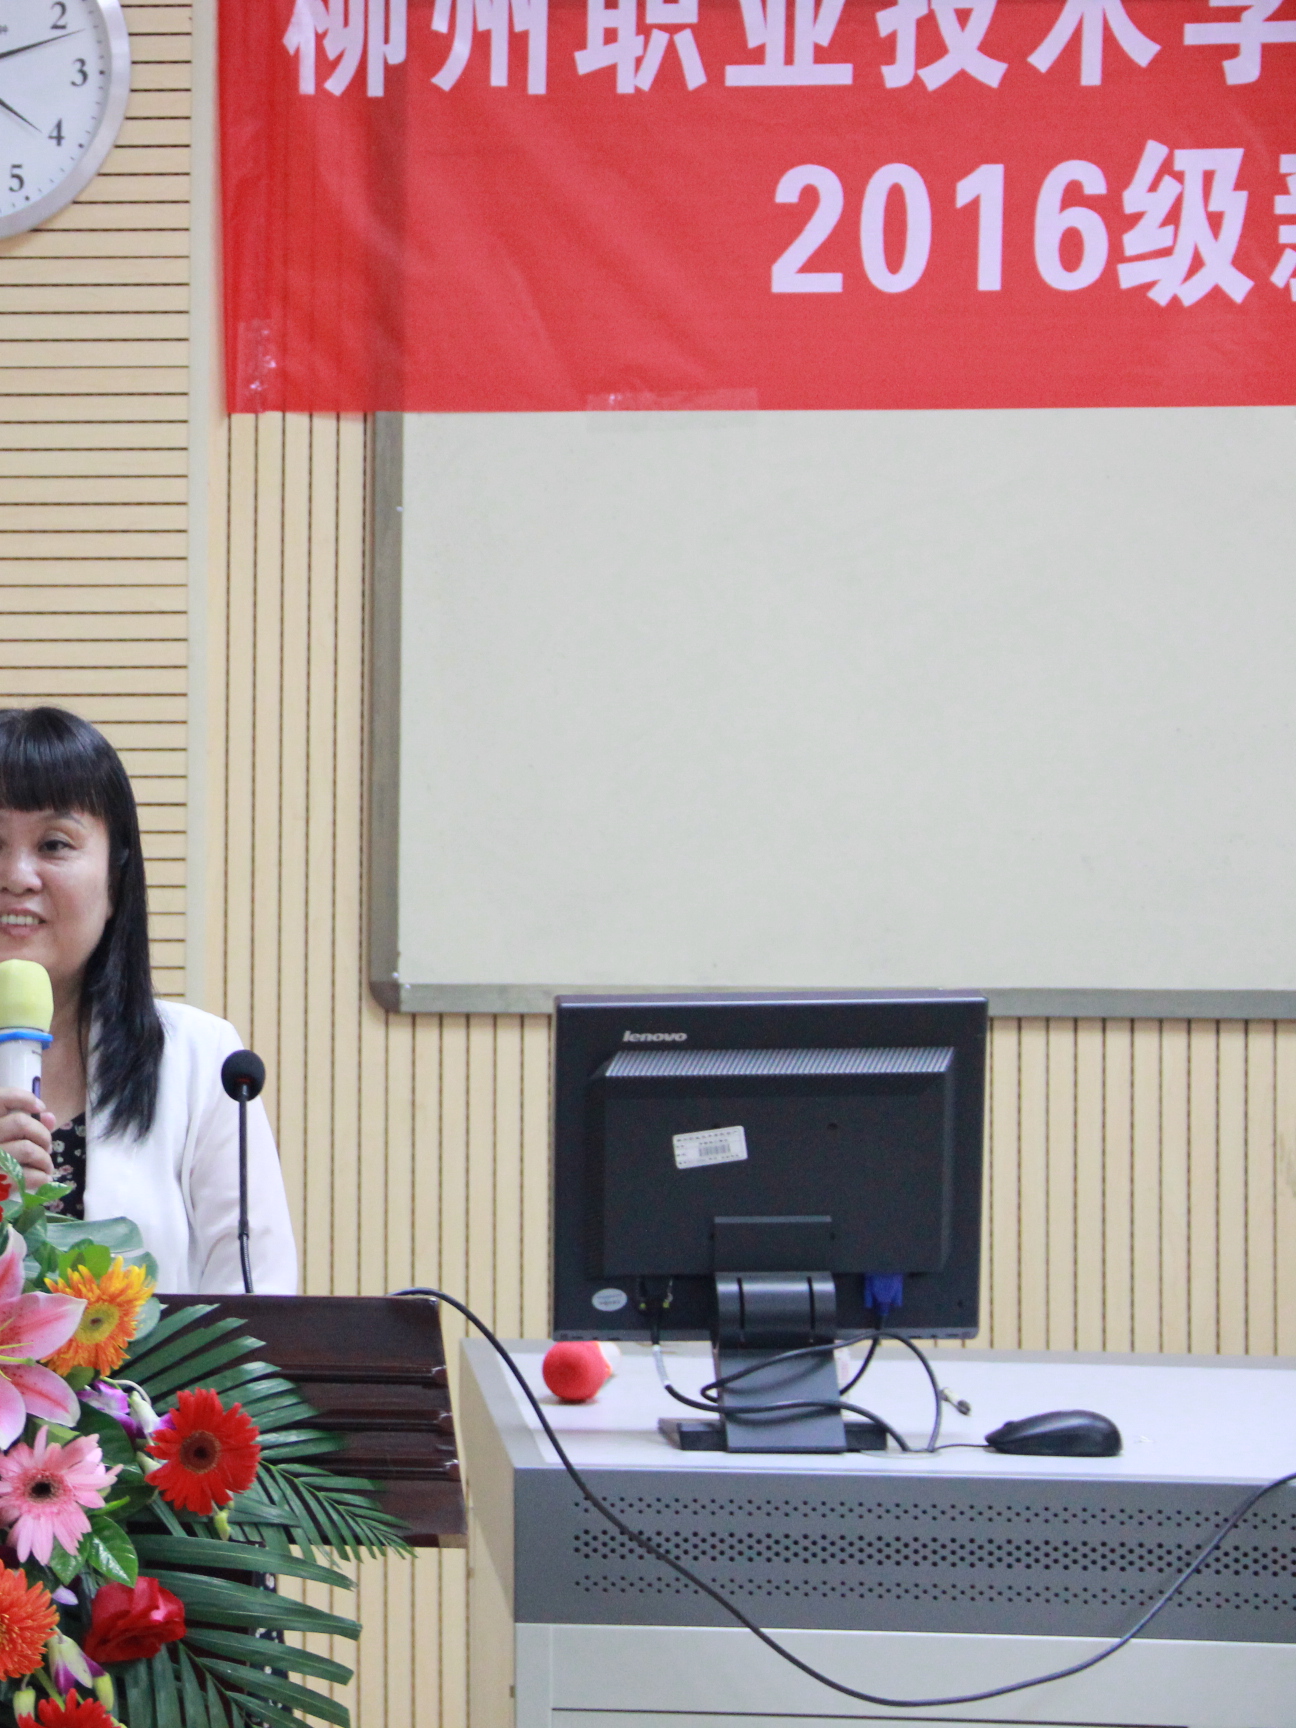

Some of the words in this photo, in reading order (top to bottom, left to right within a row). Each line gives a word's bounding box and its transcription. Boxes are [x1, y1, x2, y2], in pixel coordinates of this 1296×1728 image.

[50, 1, 68, 30] 2
[71, 58, 88, 87] 3
[47, 118, 65, 147] 4
[9, 164, 25, 193] 5
[771, 139, 1296, 307] 2016级
[622, 1030, 688, 1042] lenovo
